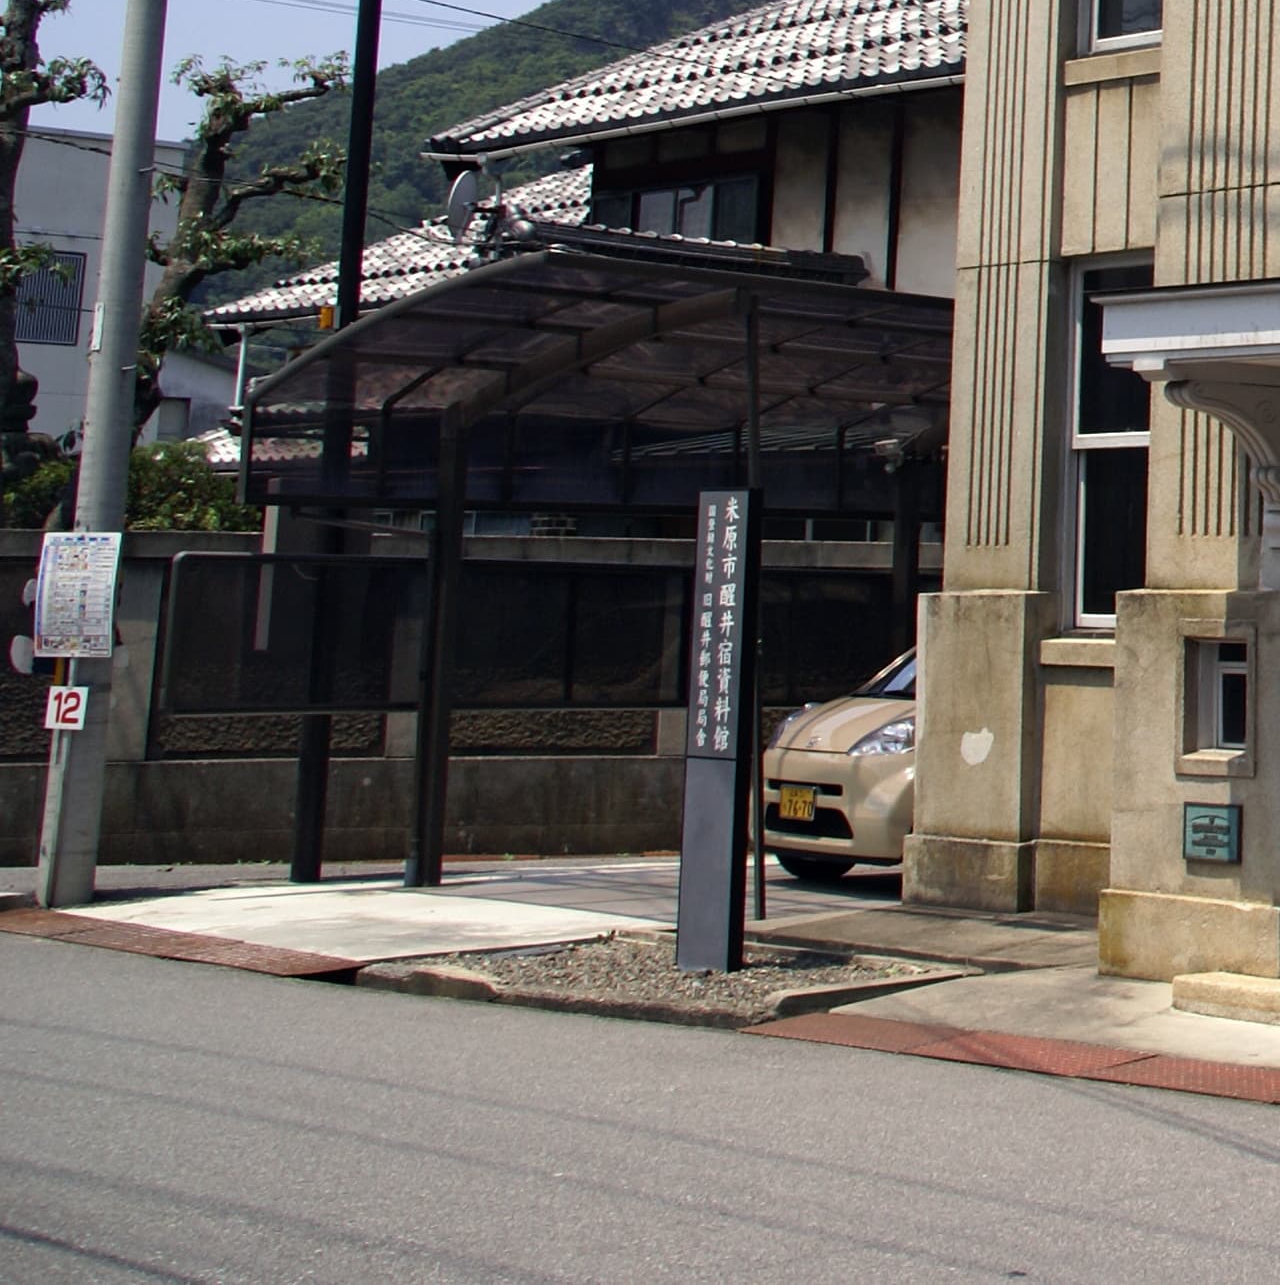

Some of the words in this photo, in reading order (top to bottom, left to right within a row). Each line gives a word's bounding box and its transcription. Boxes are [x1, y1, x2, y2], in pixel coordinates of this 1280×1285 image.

[713, 496, 740, 751] 米原市醒井宿資料館
[54, 691, 81, 724] 12
